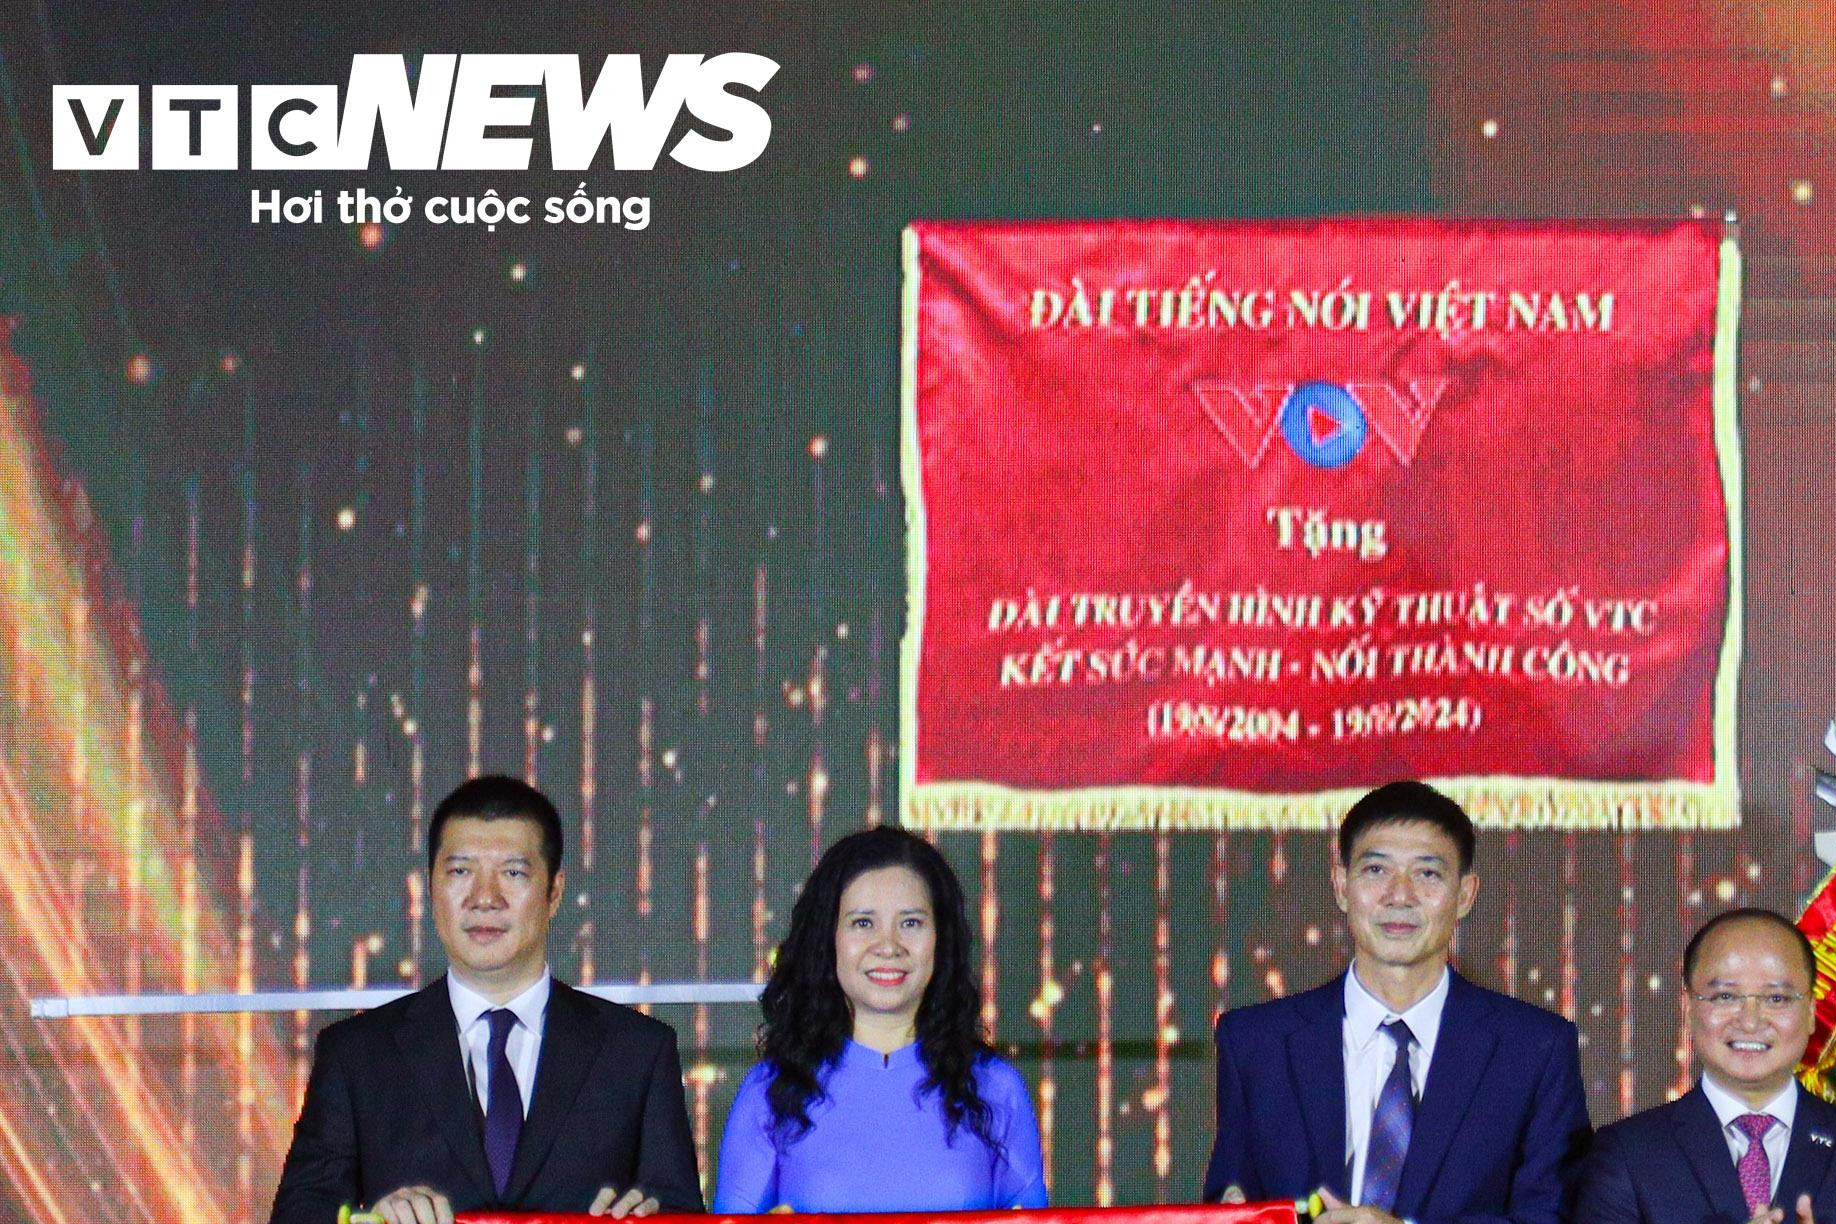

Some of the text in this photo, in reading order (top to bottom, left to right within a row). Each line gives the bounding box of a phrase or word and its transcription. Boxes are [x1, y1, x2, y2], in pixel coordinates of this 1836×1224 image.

[1031, 270, 1614, 341] ĐÀI TIẾNG NÓI VIỆT NAM
[1267, 507, 1386, 559] Tặng
[988, 578, 1660, 636] ĐÀI TRUYỀN HÌNH KỸ THUẬT SỐ VTC
[1000, 635, 1081, 687] KẾT
[1085, 636, 1166, 682] SỨC
[1172, 644, 1282, 688] MẠNH
[1310, 632, 1378, 683] NỐI
[1386, 633, 1514, 676] THÀNH
[1522, 639, 1630, 686] CÔNG
